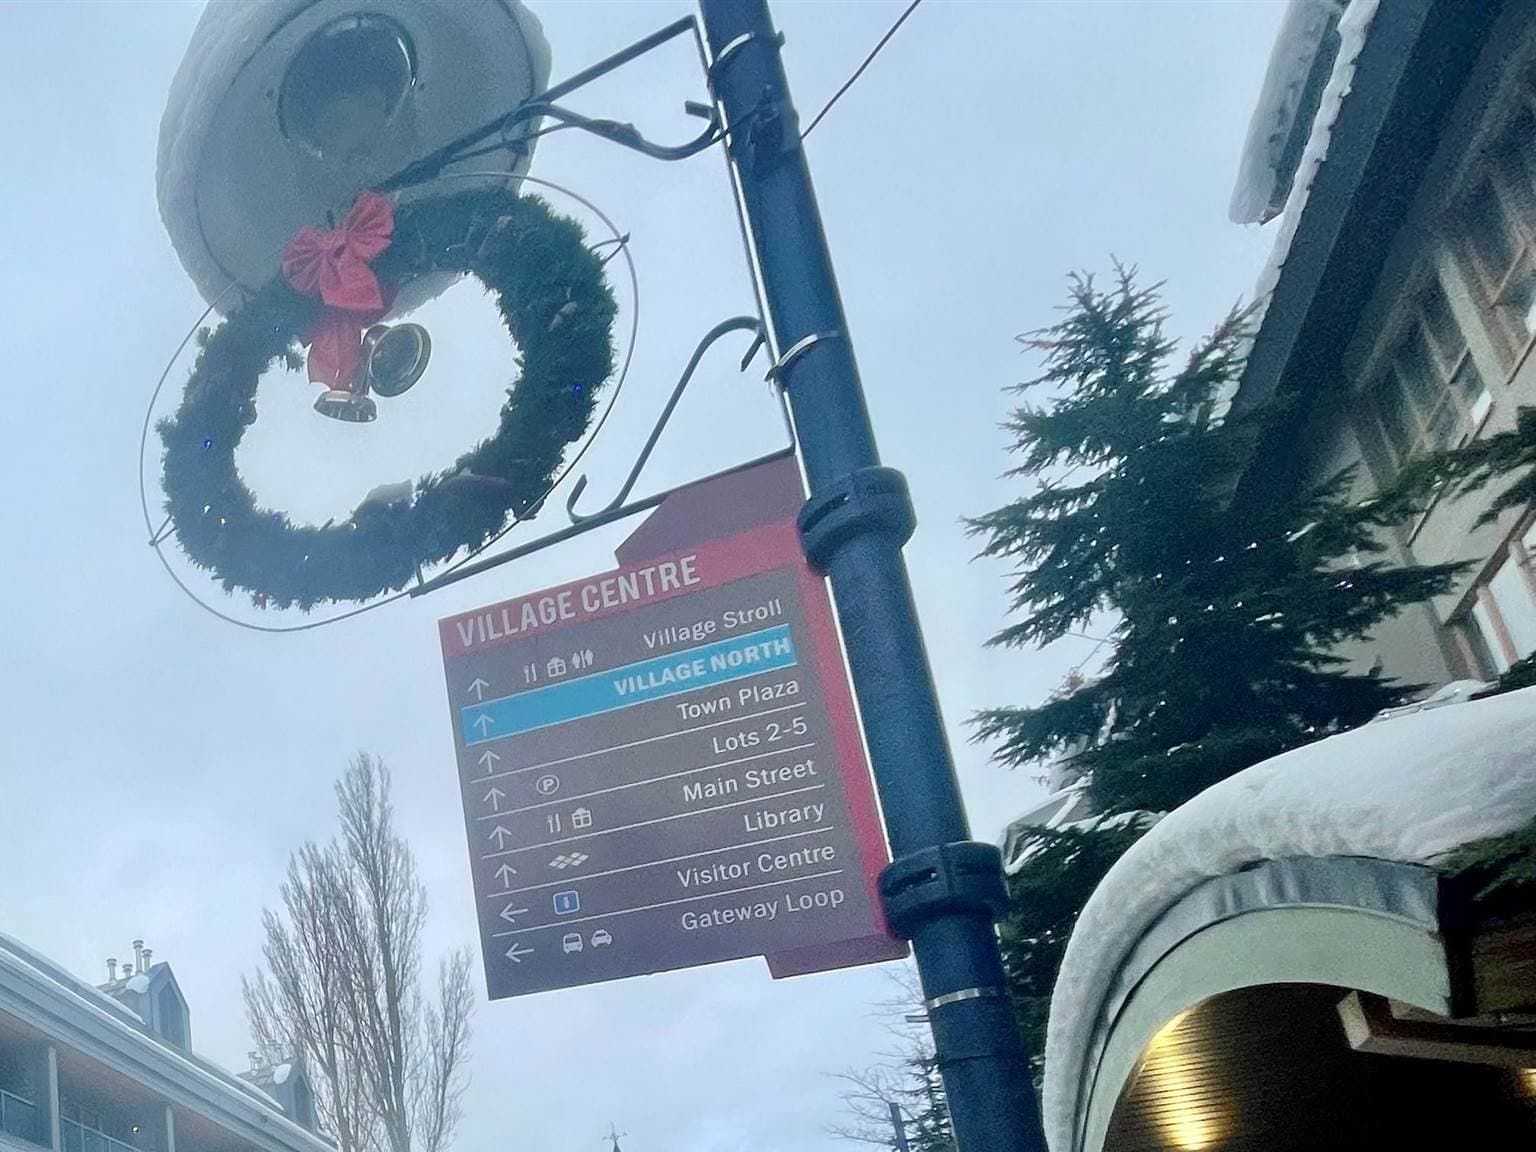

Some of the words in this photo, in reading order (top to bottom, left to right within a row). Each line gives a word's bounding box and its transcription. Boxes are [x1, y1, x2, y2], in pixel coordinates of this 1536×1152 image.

[457, 590, 576, 648] VILLAGE
[581, 555, 701, 612] CENTRE
[643, 614, 716, 650] Village
[723, 598, 782, 629] Stroll
[614, 658, 707, 696] VILLAGE
[710, 637, 792, 673] NORTH
[676, 696, 731, 720] Town
[738, 679, 800, 706] Plaza
[713, 729, 760, 754] Lots
[766, 716, 808, 742] 2-5
[682, 777, 738, 802] Main
[745, 759, 817, 789] Street
[744, 802, 825, 832] Library
[677, 860, 750, 888] Visitor
[757, 845, 835, 873] Centre
[681, 900, 779, 931] Gateway
[786, 888, 845, 912] Loop
